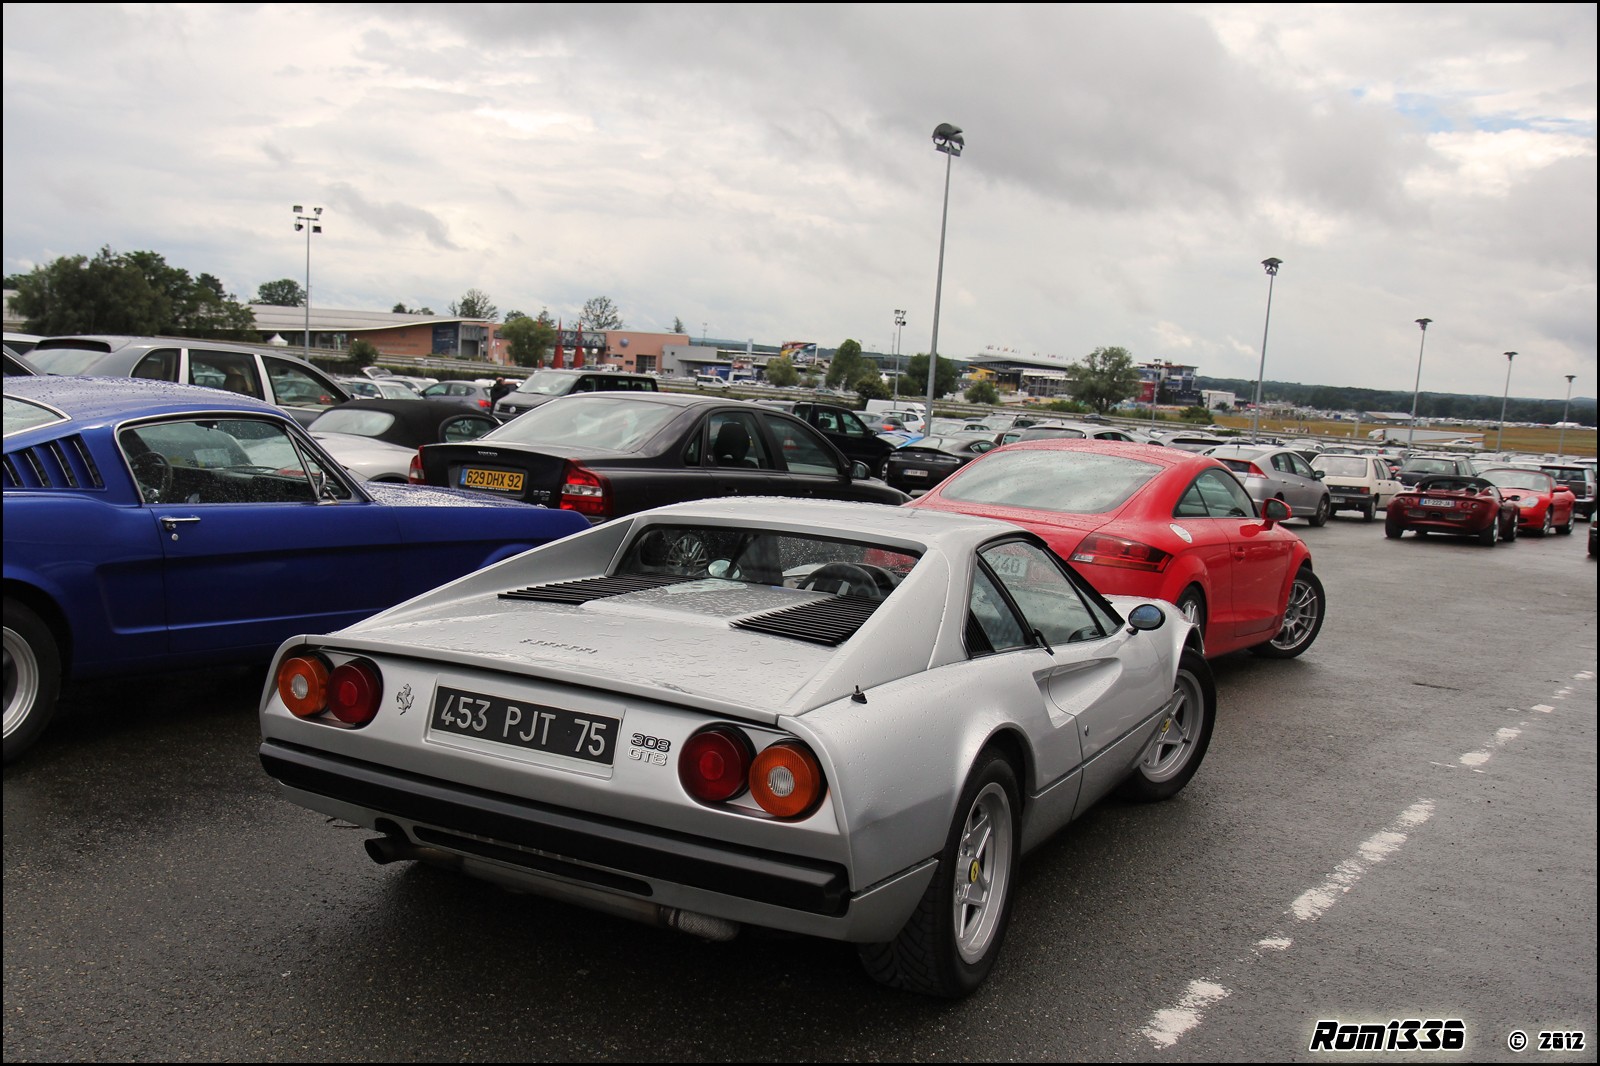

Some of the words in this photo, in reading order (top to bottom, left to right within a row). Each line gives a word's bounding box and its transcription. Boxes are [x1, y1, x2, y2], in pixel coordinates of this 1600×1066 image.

[466, 470, 486, 484] 629
[486, 472, 506, 487] DHX
[507, 474, 522, 489] 92
[441, 694, 491, 732] 453
[502, 706, 556, 746] PJT
[573, 718, 607, 756] 75
[630, 732, 672, 752] 308
[627, 748, 668, 767] GTB
